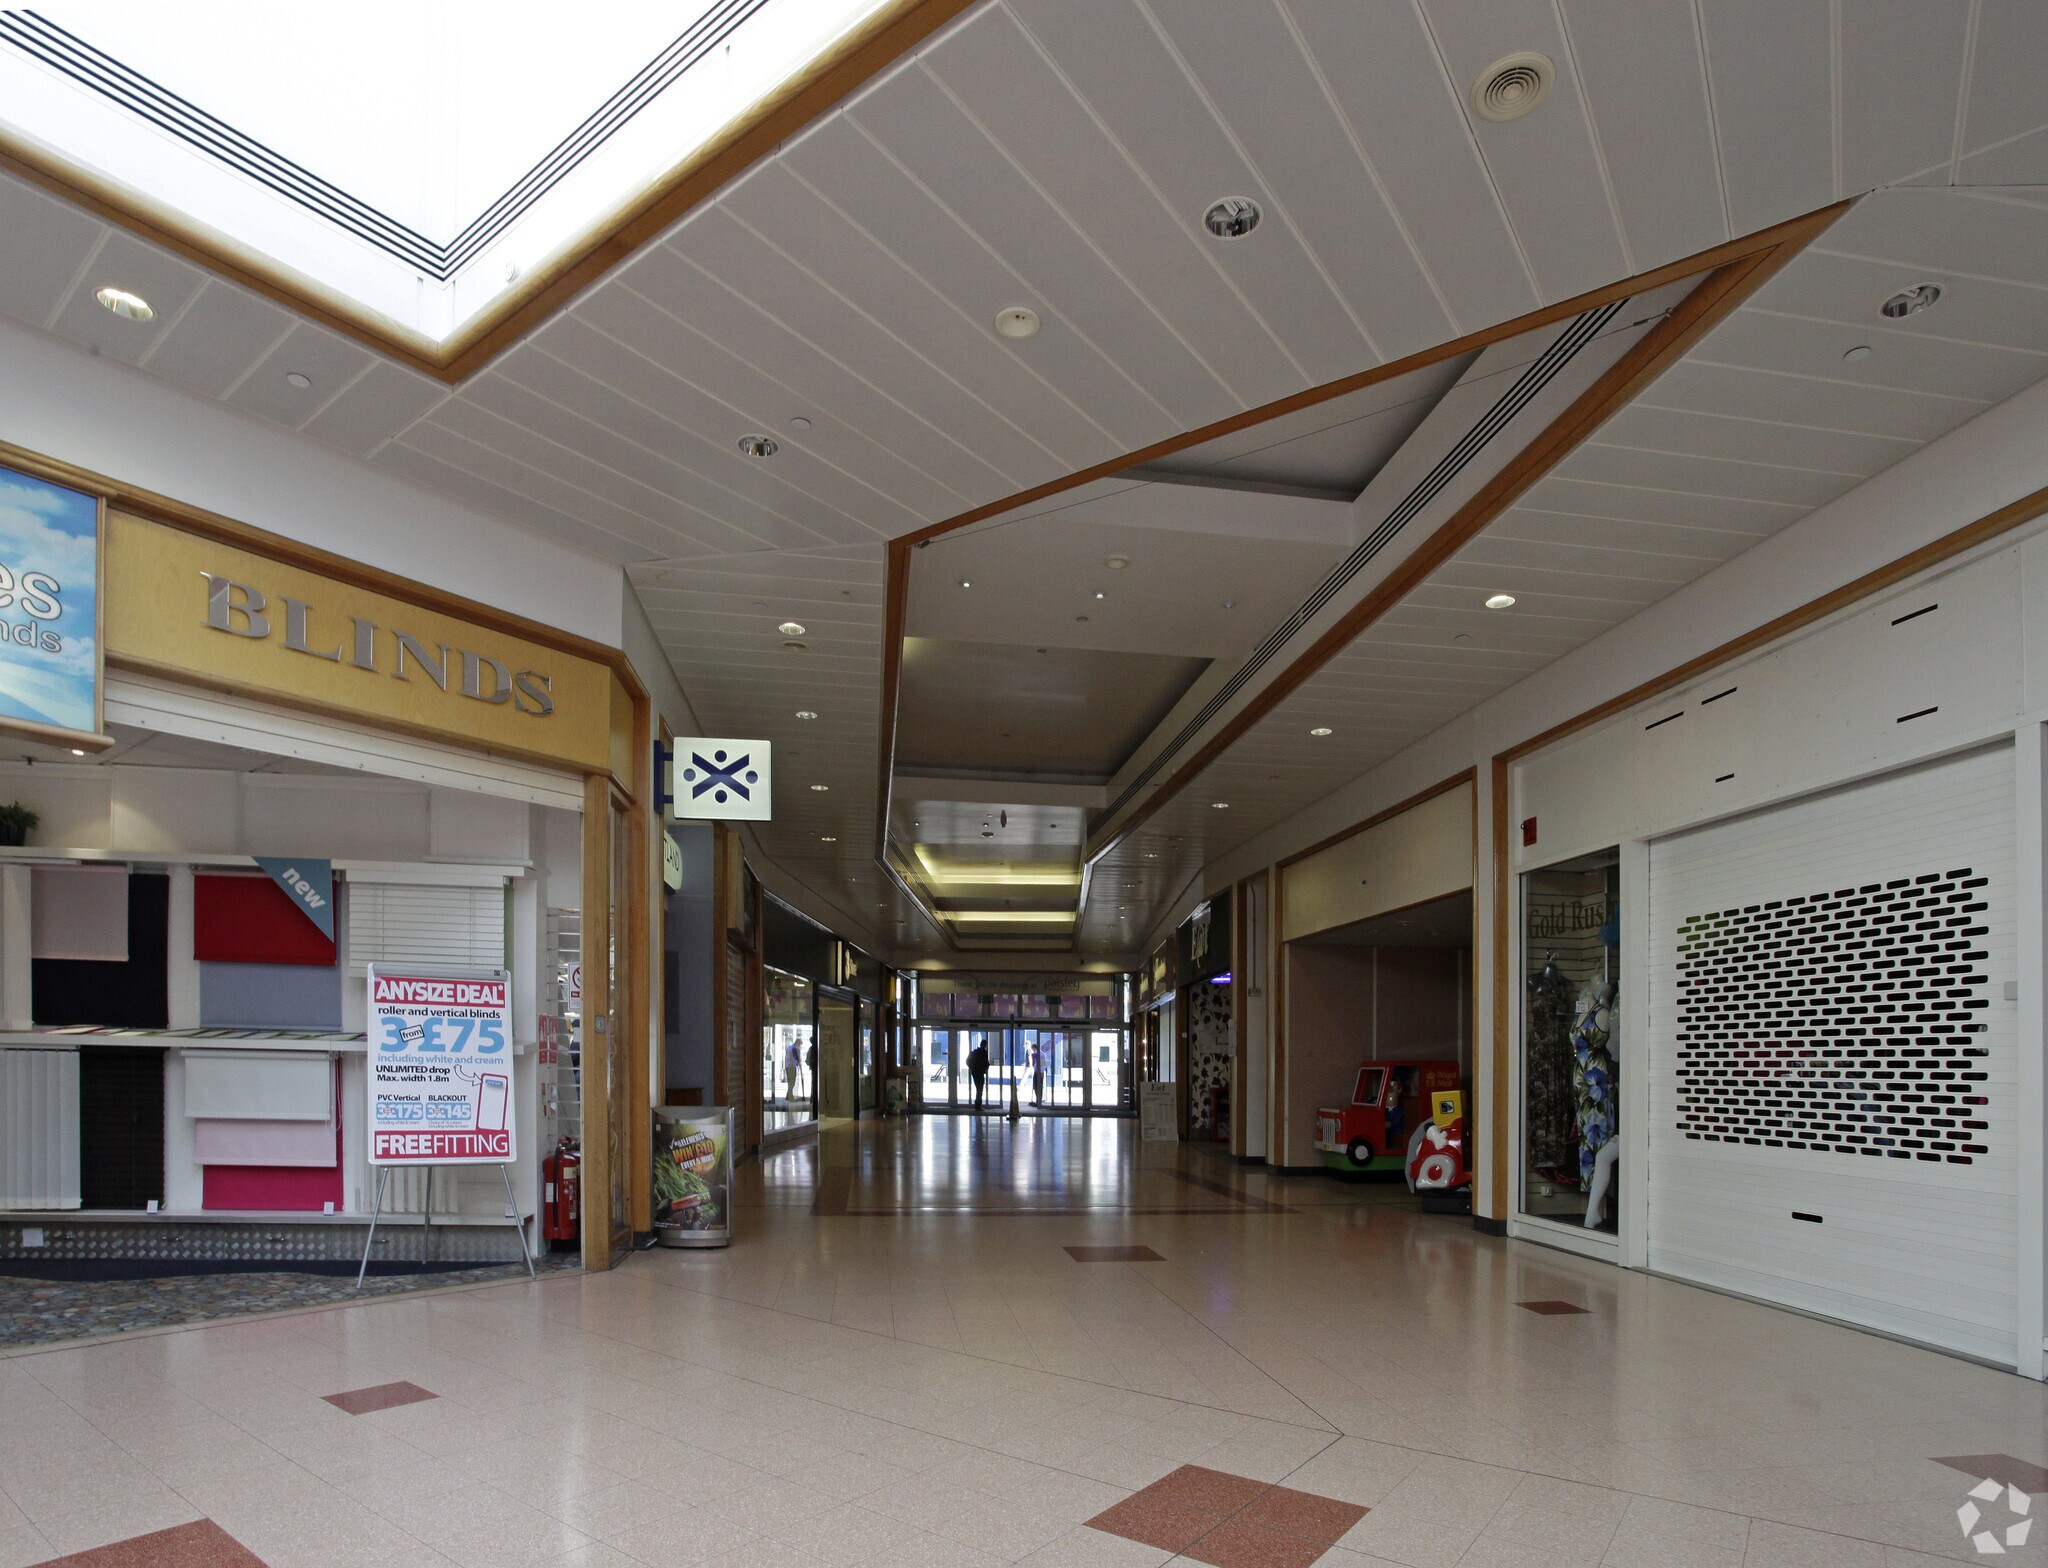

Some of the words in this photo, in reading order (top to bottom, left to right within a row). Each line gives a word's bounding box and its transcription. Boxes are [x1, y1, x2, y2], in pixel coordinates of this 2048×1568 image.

[199, 569, 556, 718] BLINDS
[281, 867, 326, 909] new
[1529, 902, 1565, 938] Gold
[376, 980, 454, 1003] ANYSIZE
[1044, 976, 1080, 991] paisley
[378, 1006, 406, 1016] roller
[408, 1006, 428, 1016] and
[430, 1007, 468, 1018] vertical
[470, 1008, 501, 1019] blinds
[380, 1016, 408, 1053] 3
[402, 1028, 423, 1040] from
[418, 1016, 505, 1054] £75
[377, 1053, 424, 1065] including
[426, 1054, 453, 1064] white
[454, 1055, 473, 1064] and
[475, 1056, 504, 1065] cream
[376, 1065, 428, 1073] UNLIMITED
[429, 1065, 451, 1075] drop
[377, 1074, 399, 1082] Max.
[401, 1074, 426, 1082] width
[672, 1145, 694, 1164] WIN
